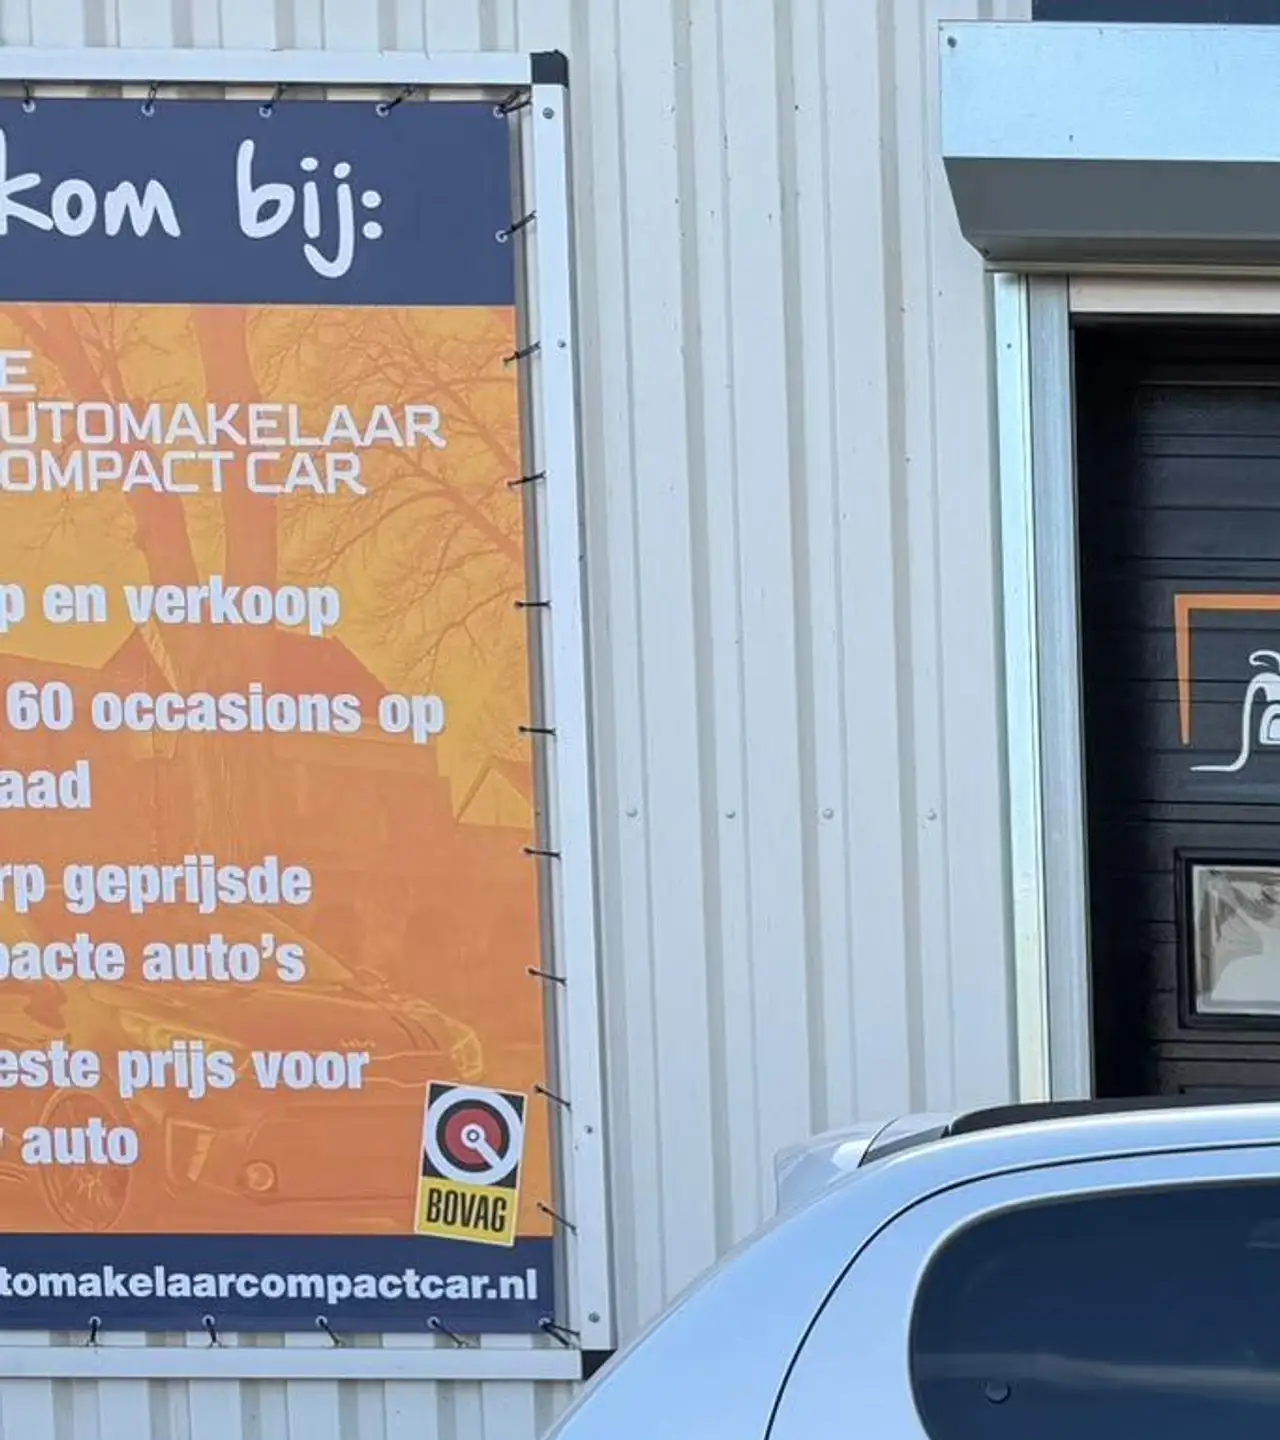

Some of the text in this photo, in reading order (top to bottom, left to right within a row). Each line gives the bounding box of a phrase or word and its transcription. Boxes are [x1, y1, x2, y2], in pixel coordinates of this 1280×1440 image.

[236, 139, 383, 278] bij:
[0, 401, 447, 448] UTOMAKELAAR
[0, 450, 366, 495] OMPACT CAR
[43, 583, 107, 623] en
[124, 575, 340, 636] verkoop
[6, 681, 444, 742] 60 occasions op
[0, 760, 91, 808] aad
[63, 855, 312, 914] geprijsde
[118, 1041, 235, 1099] prijs
[252, 1050, 370, 1089] voor
[21, 1117, 138, 1165] auto
[426, 1188, 507, 1232] BOVAG
